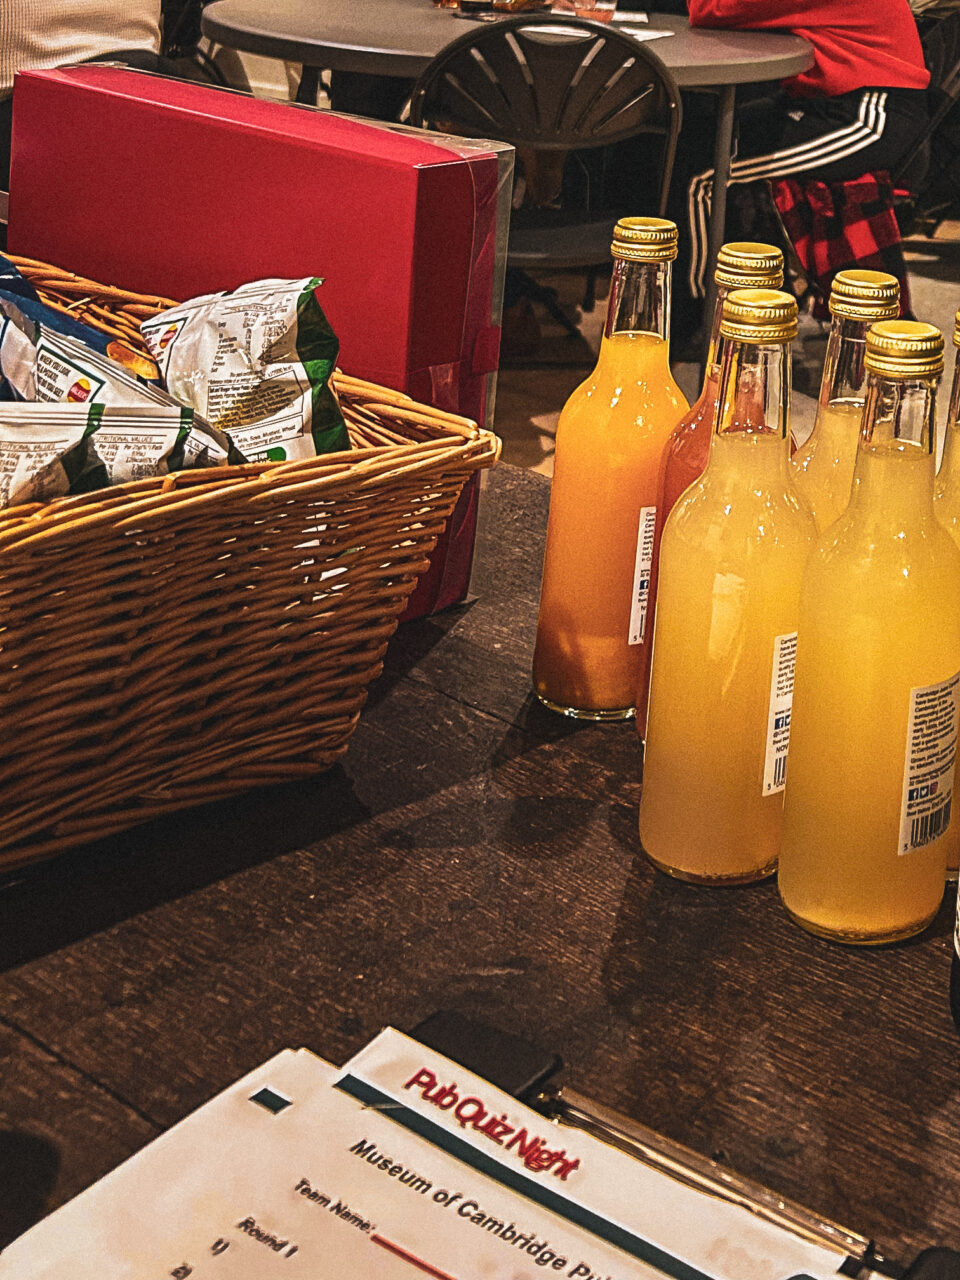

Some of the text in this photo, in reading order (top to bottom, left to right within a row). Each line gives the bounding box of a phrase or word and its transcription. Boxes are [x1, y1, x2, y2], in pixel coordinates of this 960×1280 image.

[404, 1067, 582, 1182] Pub Quiz Night
[236, 1216, 289, 1252] Round
[294, 1177, 377, 1234] Team Name:
[347, 1136, 568, 1271] Museum of Cambridge
